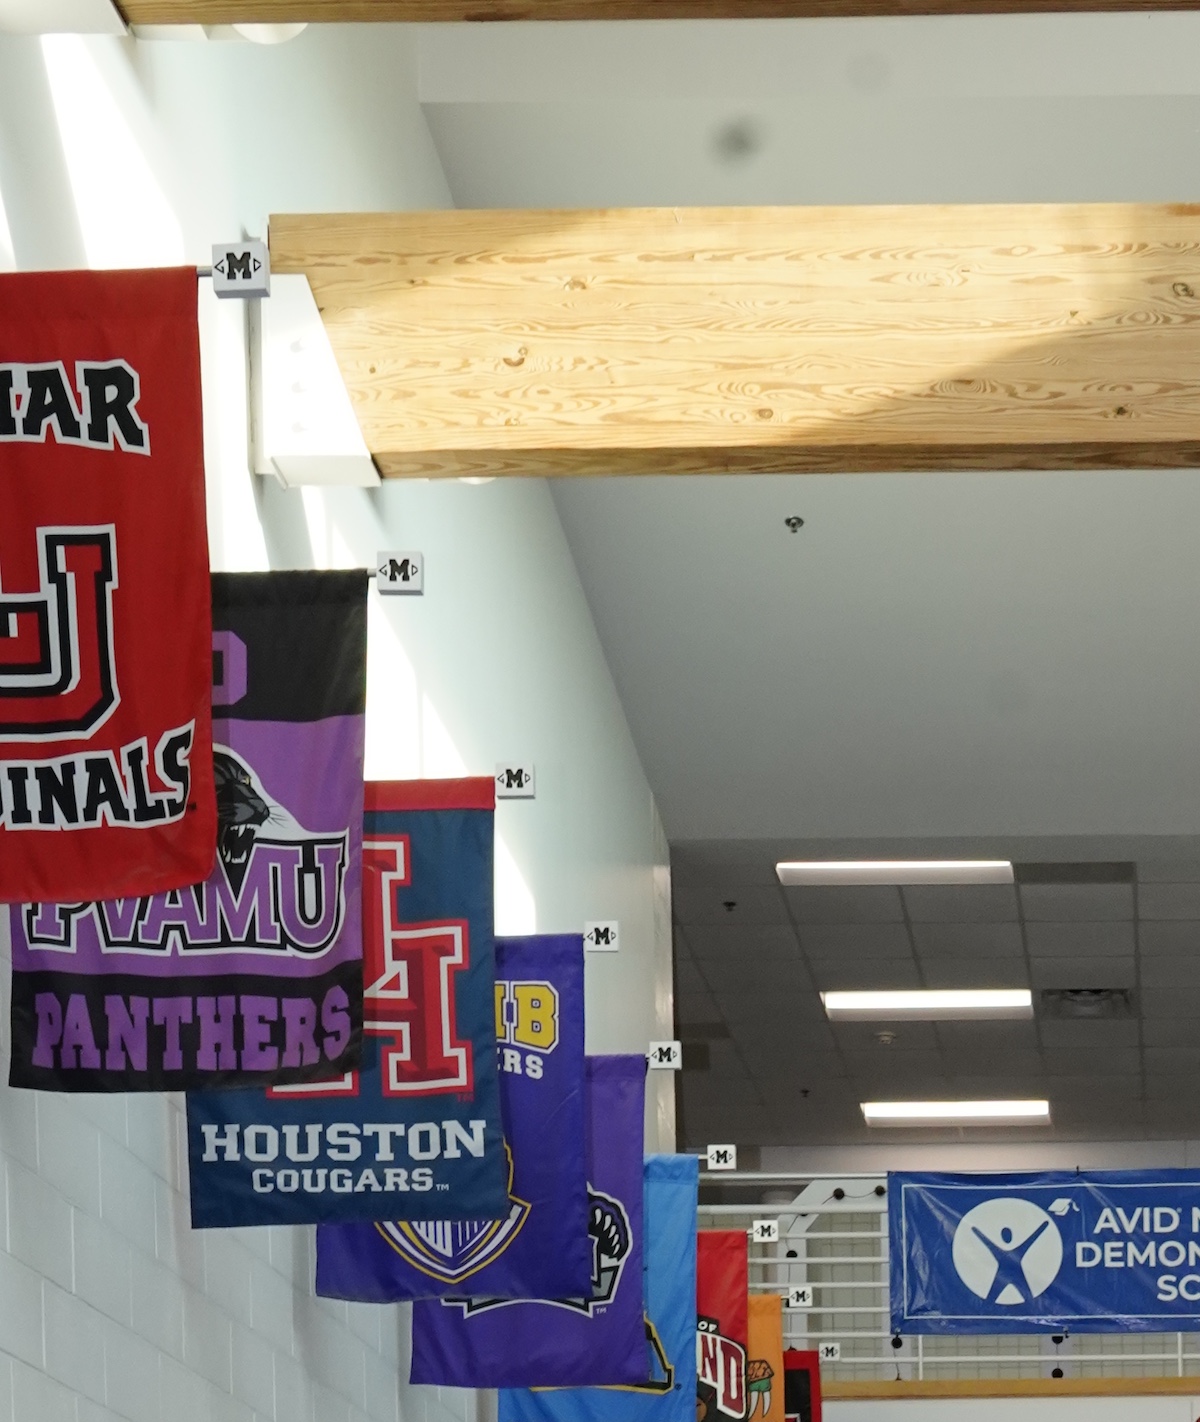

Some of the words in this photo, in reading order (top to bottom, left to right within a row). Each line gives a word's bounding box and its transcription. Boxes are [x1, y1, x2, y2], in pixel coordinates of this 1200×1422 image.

[32, 985, 351, 1071] PANTHERS
[200, 1119, 487, 1163] HOUSTON
[252, 1167, 434, 1194] COUGARS
[1093, 1206, 1178, 1236] AVID
[697, 1320, 718, 1333] OF
